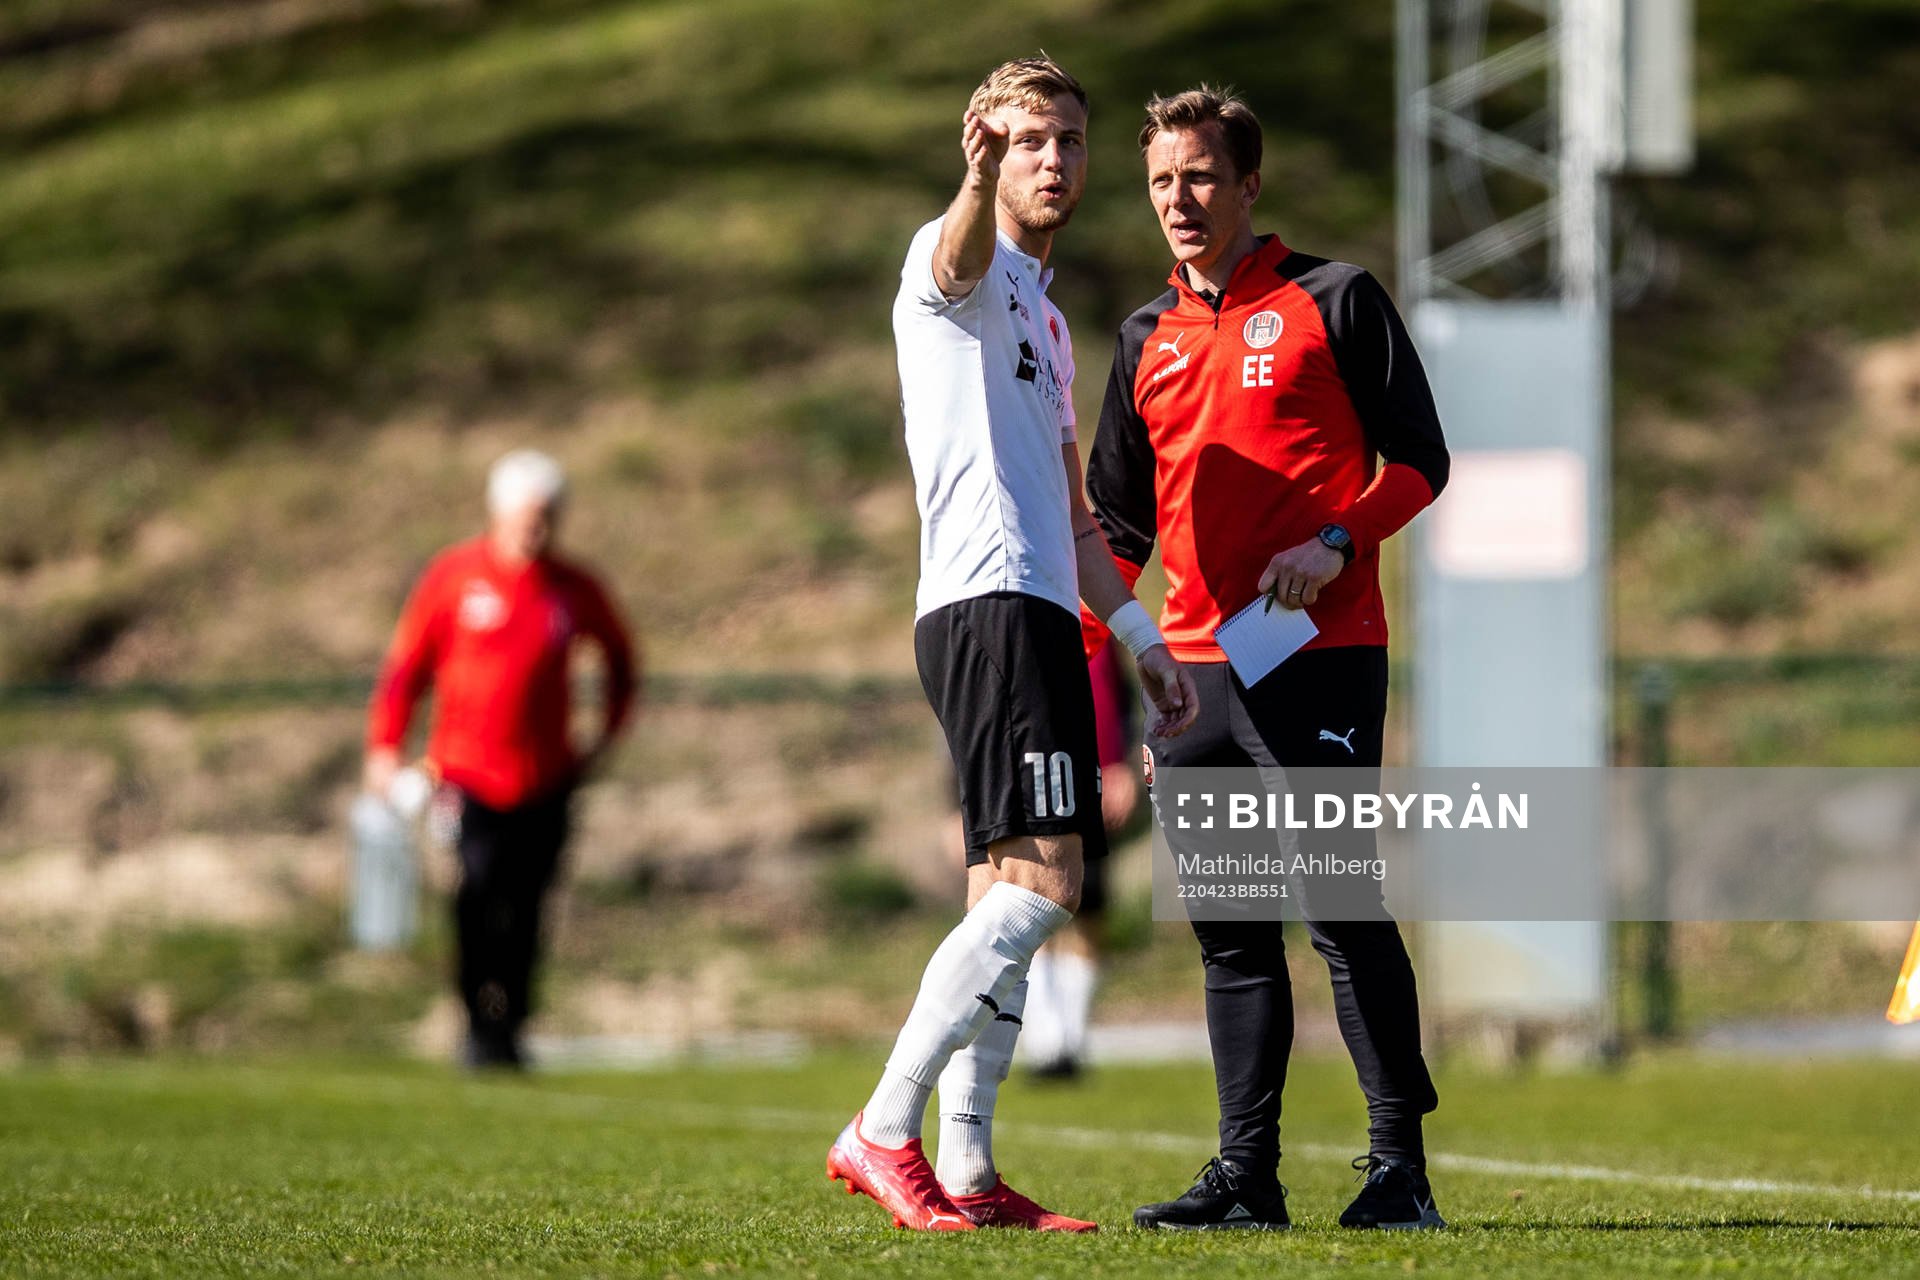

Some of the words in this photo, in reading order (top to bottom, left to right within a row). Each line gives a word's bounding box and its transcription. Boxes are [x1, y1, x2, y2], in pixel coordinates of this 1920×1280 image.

[1242, 354, 1274, 388] EE
[1024, 751, 1076, 817] 10
[951, 1115, 982, 1126] adidas
